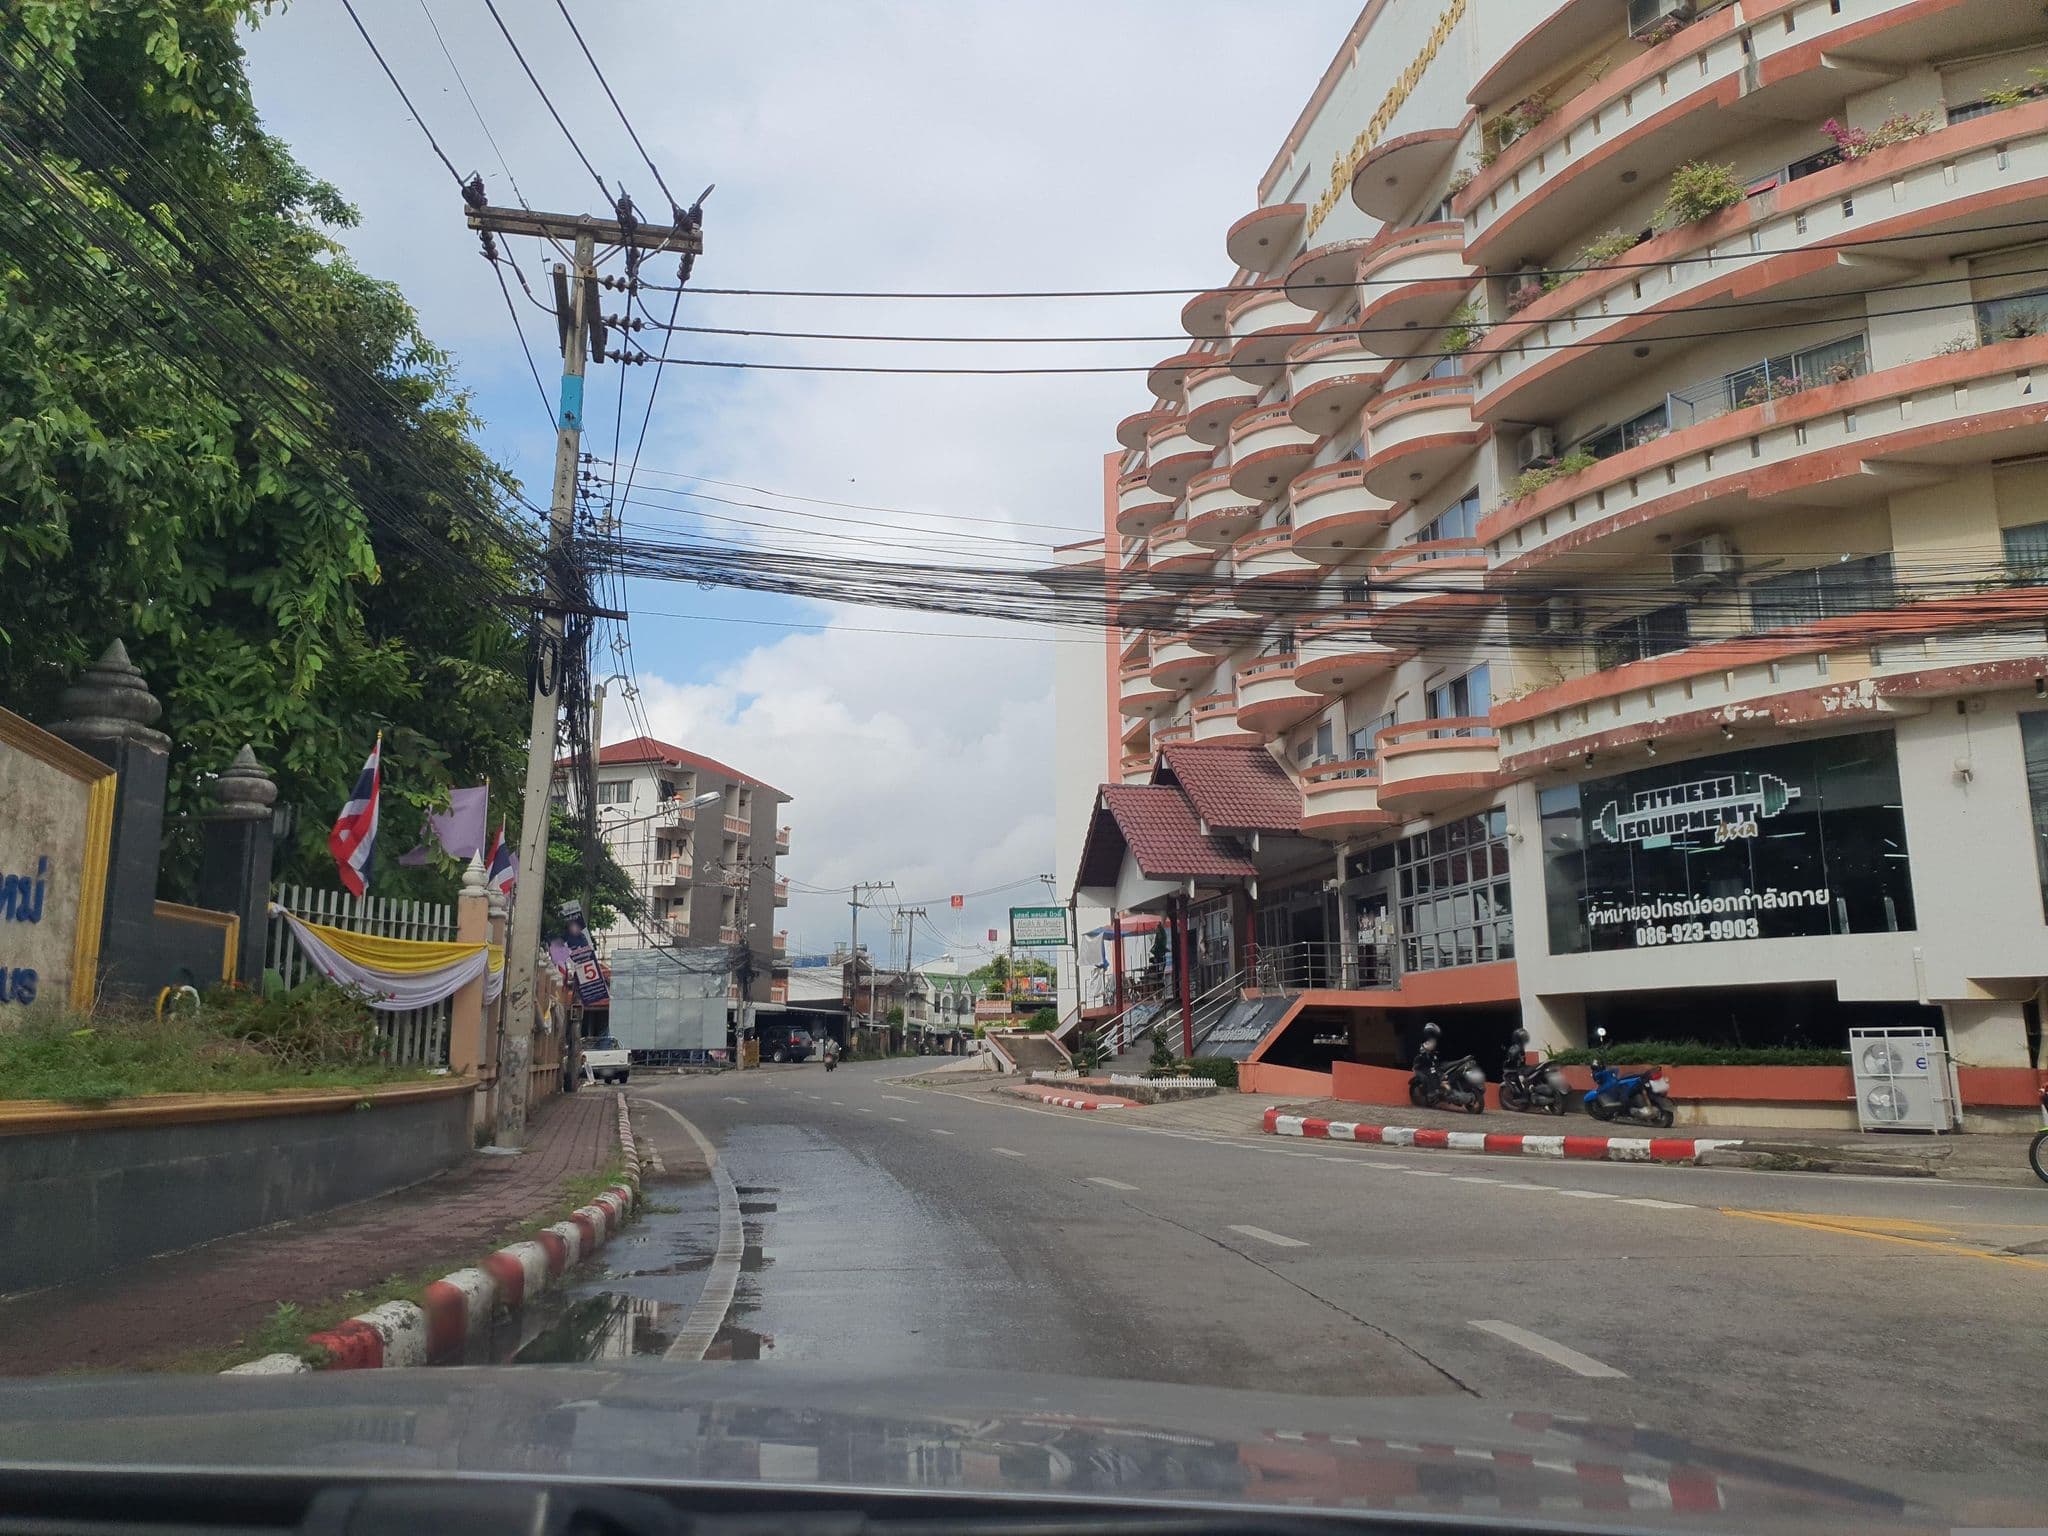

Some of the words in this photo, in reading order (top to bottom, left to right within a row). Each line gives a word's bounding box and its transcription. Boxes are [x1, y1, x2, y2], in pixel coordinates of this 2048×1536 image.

[1634, 777, 1735, 810] FITNESS
[1622, 803, 1756, 842] EQUIPMENT
[1588, 888, 1830, 926] จำหน่ายอุปกรณ์ออกกำลังกาย
[1636, 918, 1760, 946] 086-923-9903
[584, 964, 598, 980] 5
